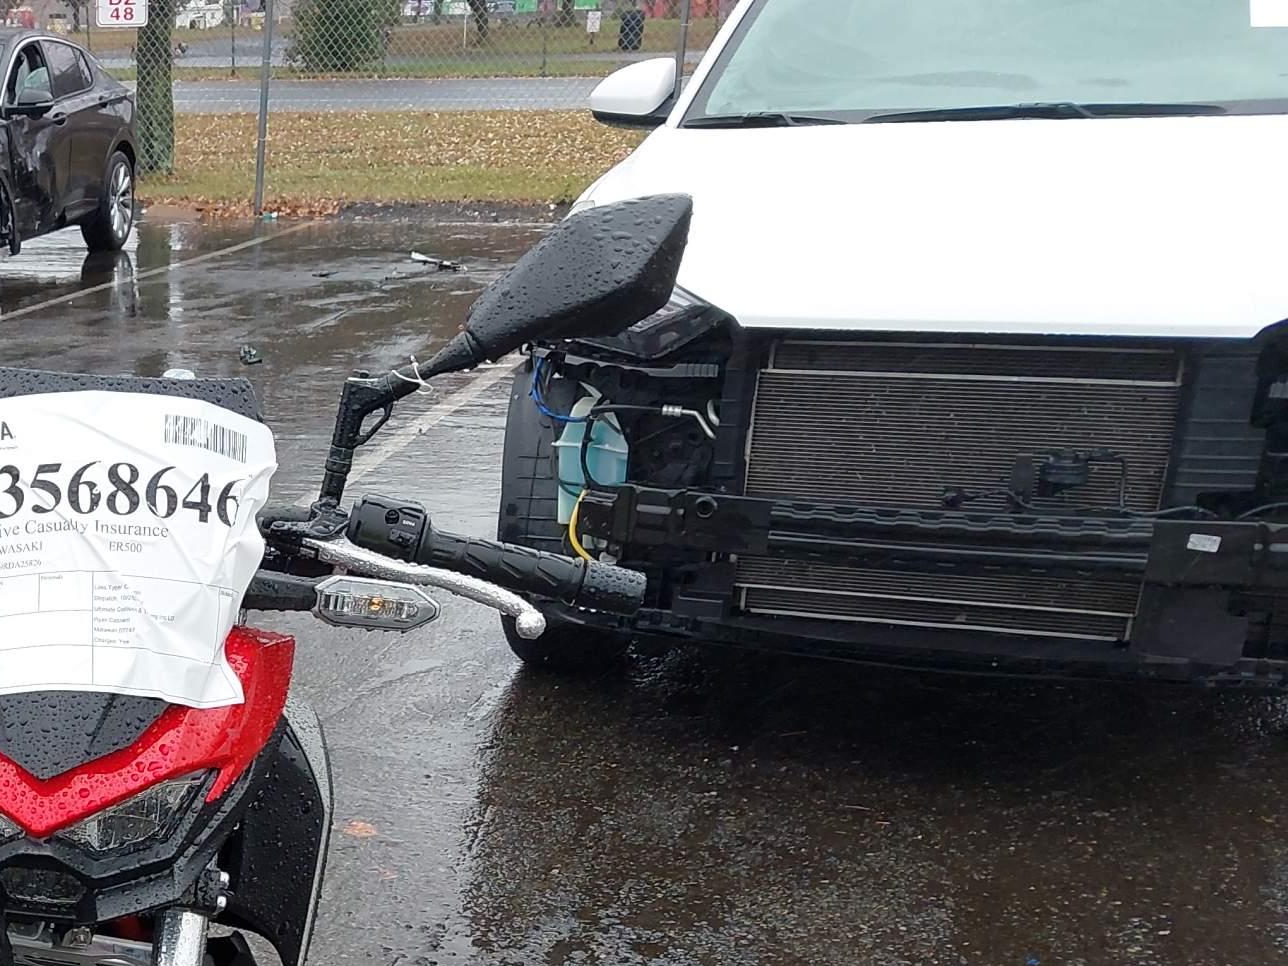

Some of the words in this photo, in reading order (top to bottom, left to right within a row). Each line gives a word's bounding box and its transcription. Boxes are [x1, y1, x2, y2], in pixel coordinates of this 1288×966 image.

[110, 7, 134, 21] 48
[25, 519, 89, 535] Casualty
[95, 519, 169, 538] Insurance
[109, 541, 143, 553] ER500
